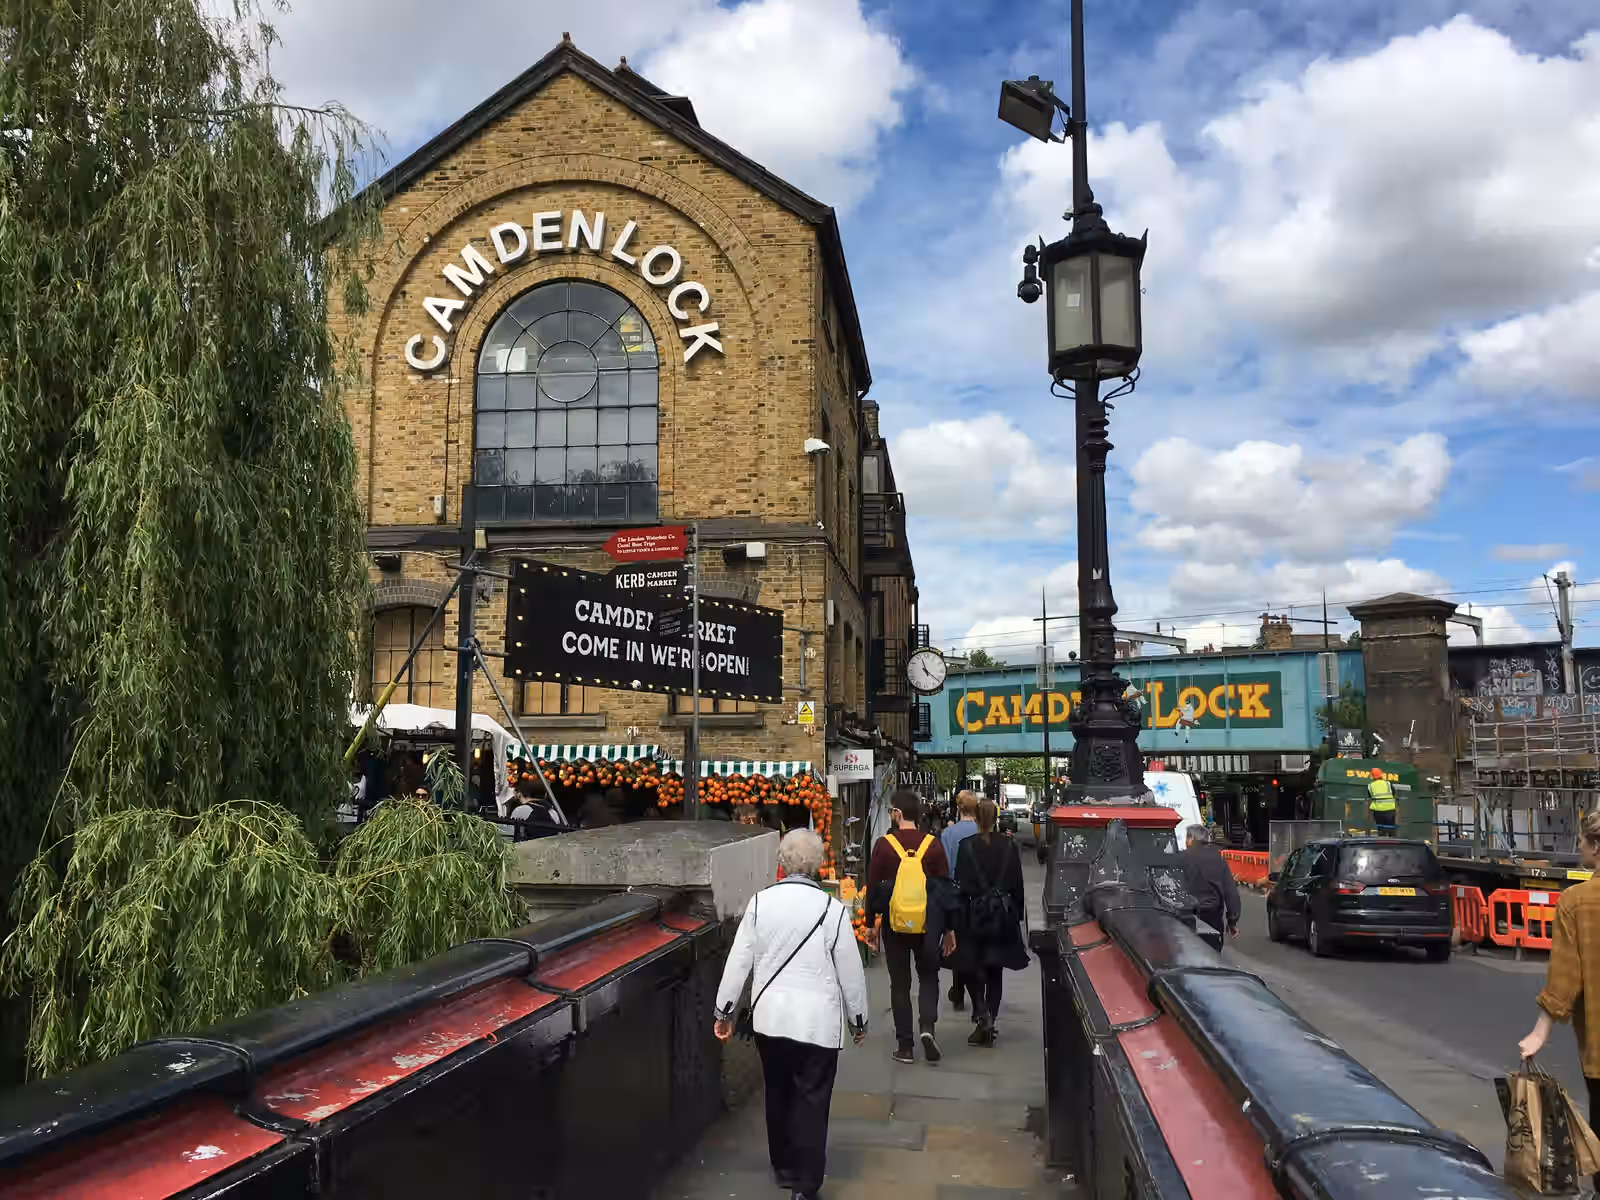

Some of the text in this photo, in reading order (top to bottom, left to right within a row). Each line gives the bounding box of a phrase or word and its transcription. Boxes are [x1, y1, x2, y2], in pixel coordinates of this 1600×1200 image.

[404, 209, 724, 372] CAMDEN LOCK
[616, 573, 645, 588] KERB
[562, 631, 620, 659] COME
[626, 640, 644, 663] IN
[956, 681, 1272, 733] CAMD LOCK
